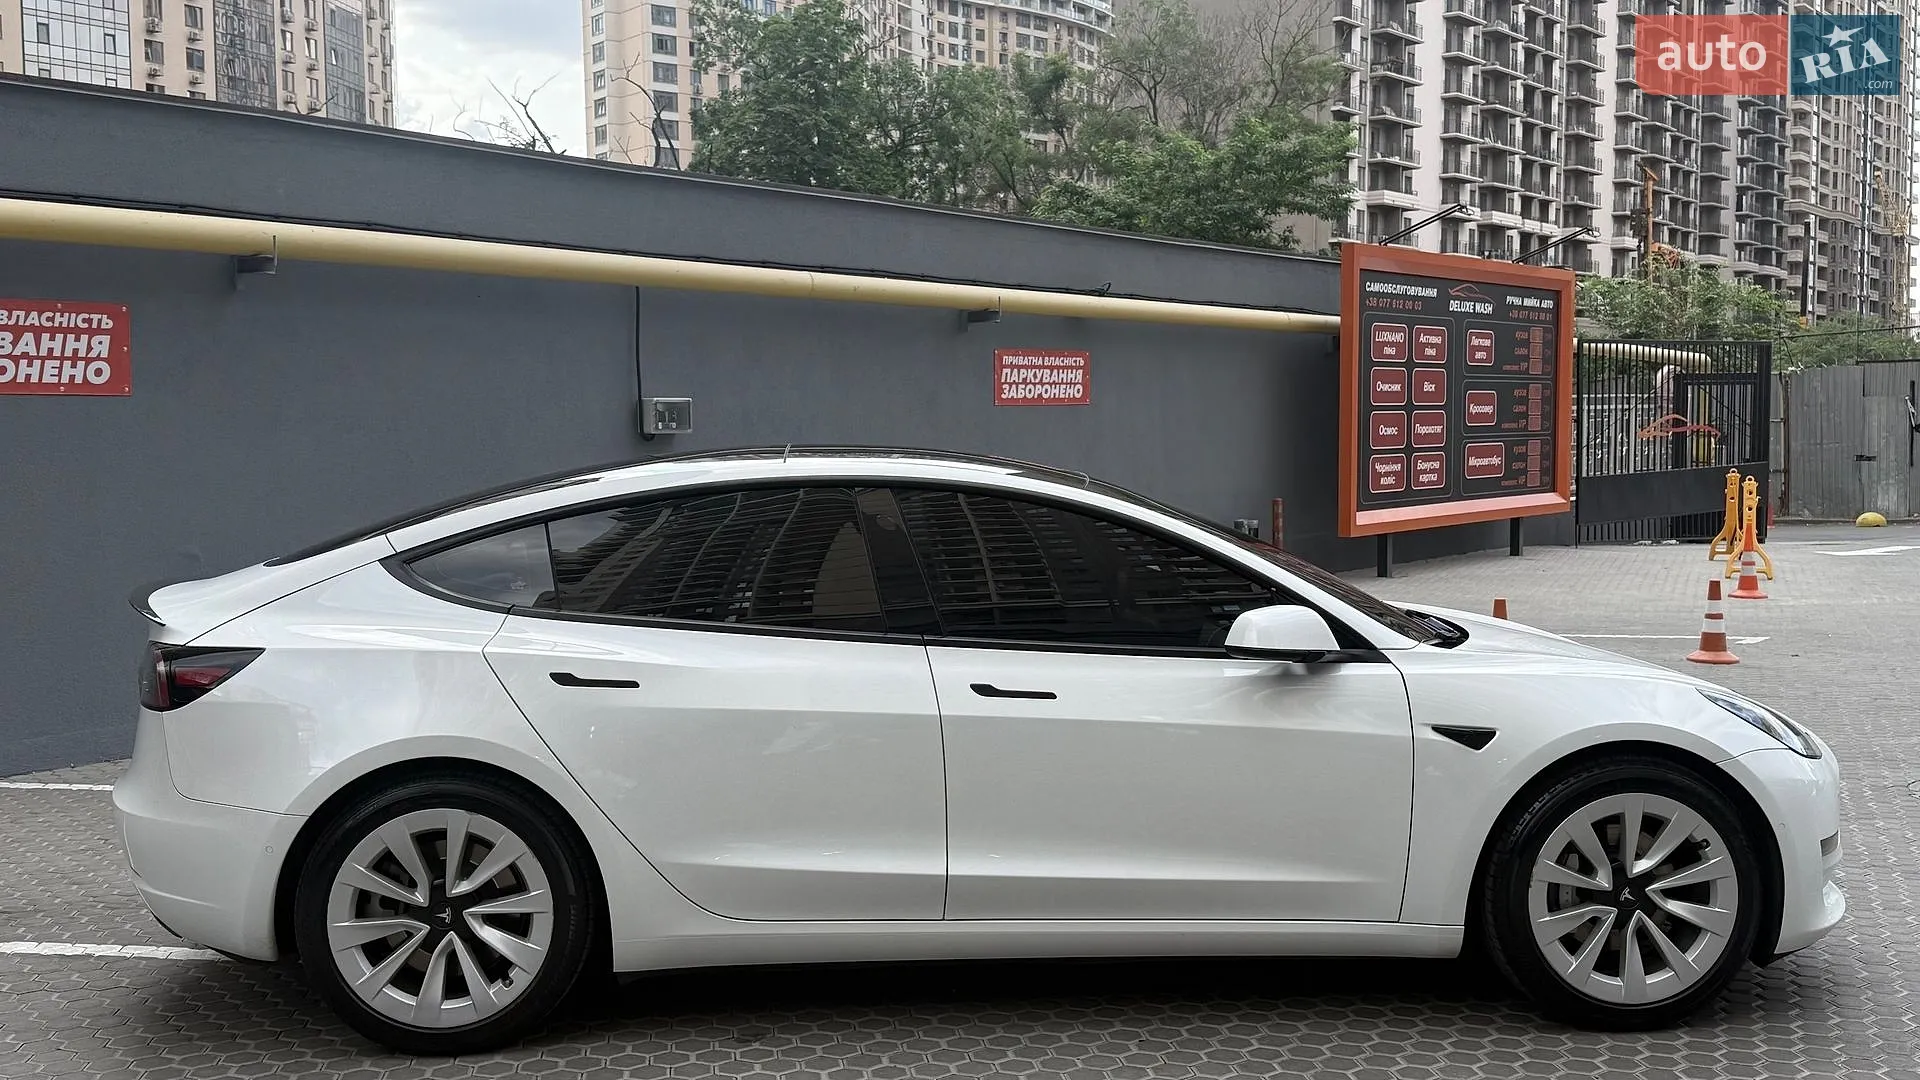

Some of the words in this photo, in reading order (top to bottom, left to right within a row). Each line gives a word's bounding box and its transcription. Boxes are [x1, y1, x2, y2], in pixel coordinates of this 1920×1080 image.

[1365, 282, 1437, 298] САМООБСЛУГОВУВАННЯ
[1449, 300, 1474, 313] DELUXE
[1475, 302, 1493, 315] WASH
[1506, 296, 1521, 306] РУЧНА
[1523, 296, 1539, 307] МИЙКА
[1541, 299, 1553, 309] АВТО
[1375, 331, 1404, 343] LUXNANO
[1419, 333, 1442, 344] Активна
[1384, 344, 1396, 355] піна
[1424, 345, 1437, 356] піна
[1002, 356, 1043, 365] ПРИВАТНА
[1044, 357, 1085, 366] ВЛАСНІСТЬ
[1474, 351, 1486, 360] авто
[1001, 368, 1083, 383] ПАРКУВАННЯ
[1001, 384, 1083, 399] ЗАБОРОНЕНО
[1376, 381, 1402, 392] Очисник
[1423, 381, 1436, 392] Віск
[1470, 403, 1494, 415] Кросовер
[1379, 425, 1399, 436] Осмос
[1415, 424, 1443, 436] Порохотяг
[1417, 460, 1440, 471] Бонусна
[1468, 455, 1501, 467] Мікроавтобус
[1380, 474, 1395, 485] коліс
[1419, 473, 1438, 483] картка
